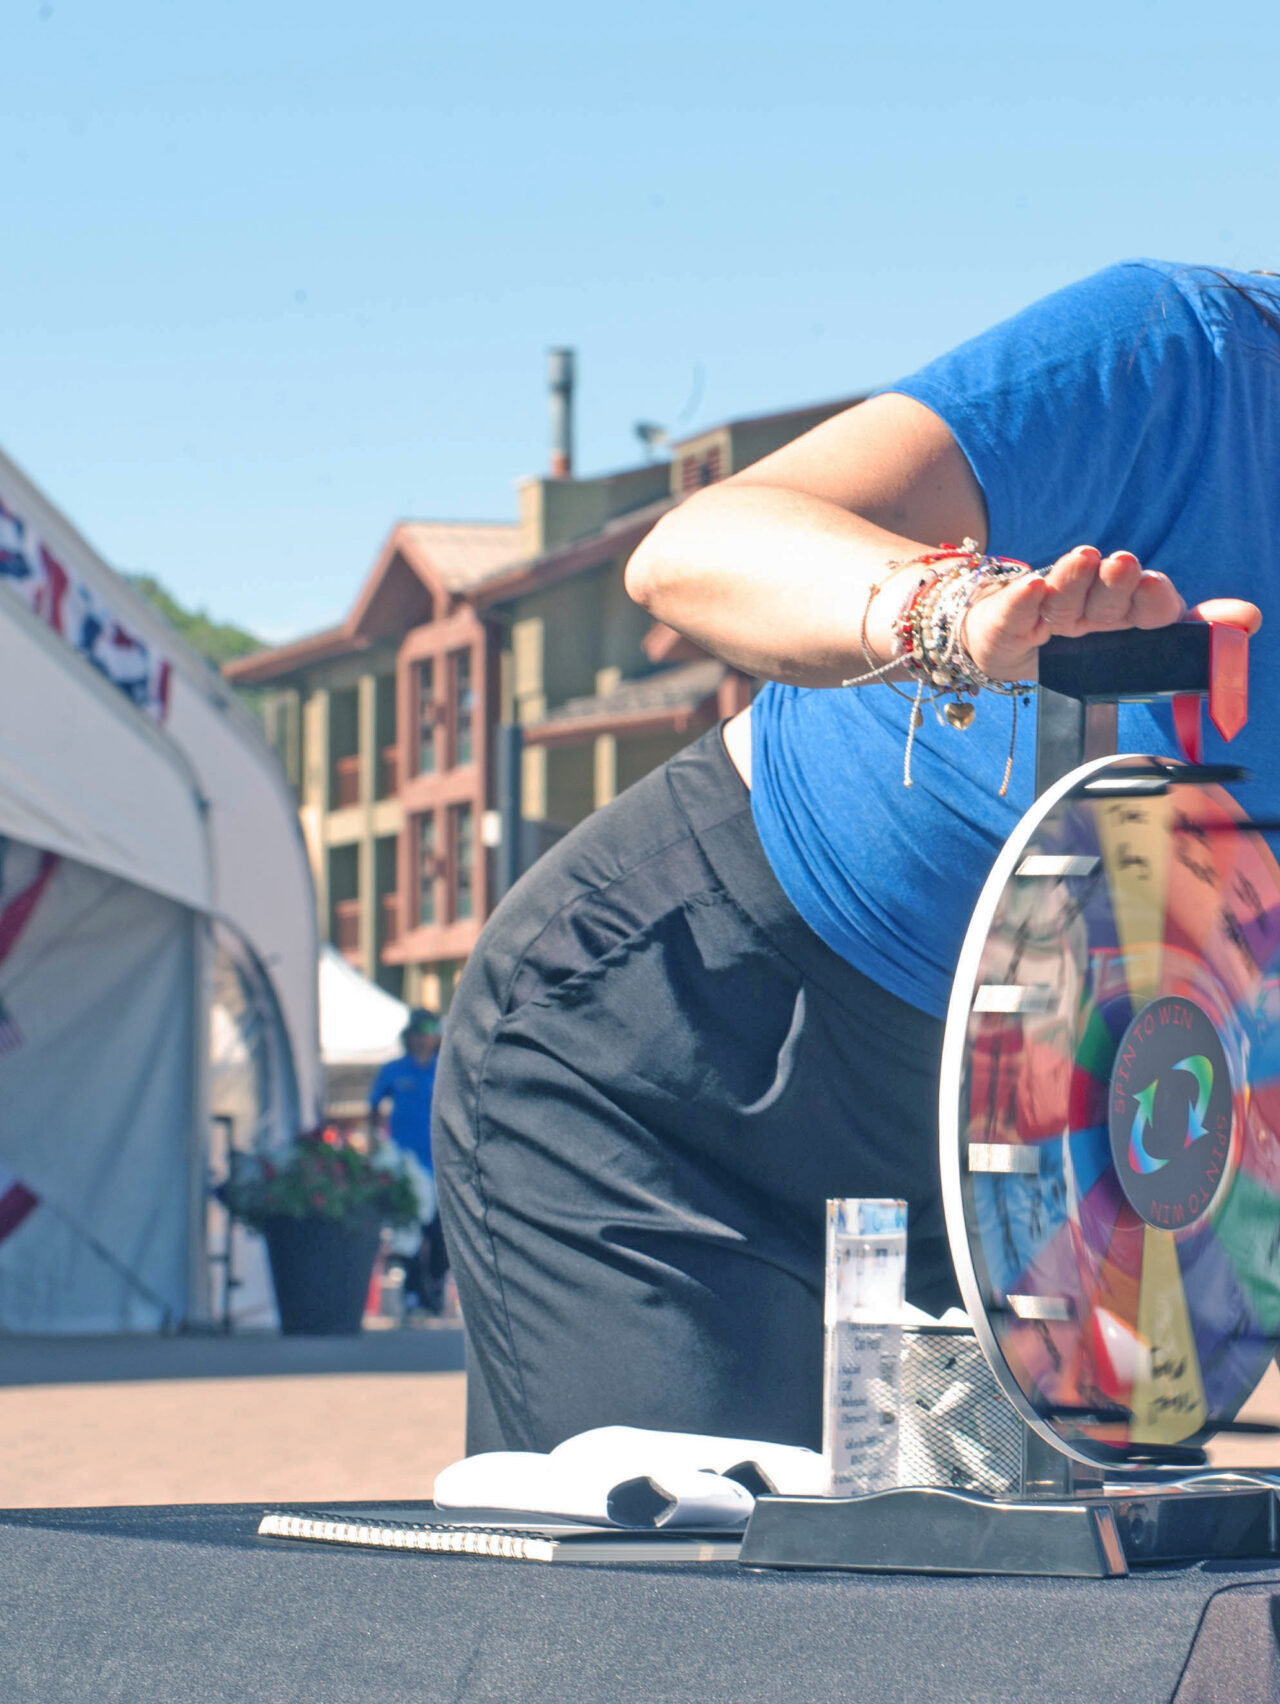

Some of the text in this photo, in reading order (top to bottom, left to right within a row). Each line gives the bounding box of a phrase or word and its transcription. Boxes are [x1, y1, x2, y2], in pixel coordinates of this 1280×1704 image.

[1114, 1004, 1194, 1115] SPIN TO WIN
[1151, 1114, 1228, 1225] SPIN TO WIN
